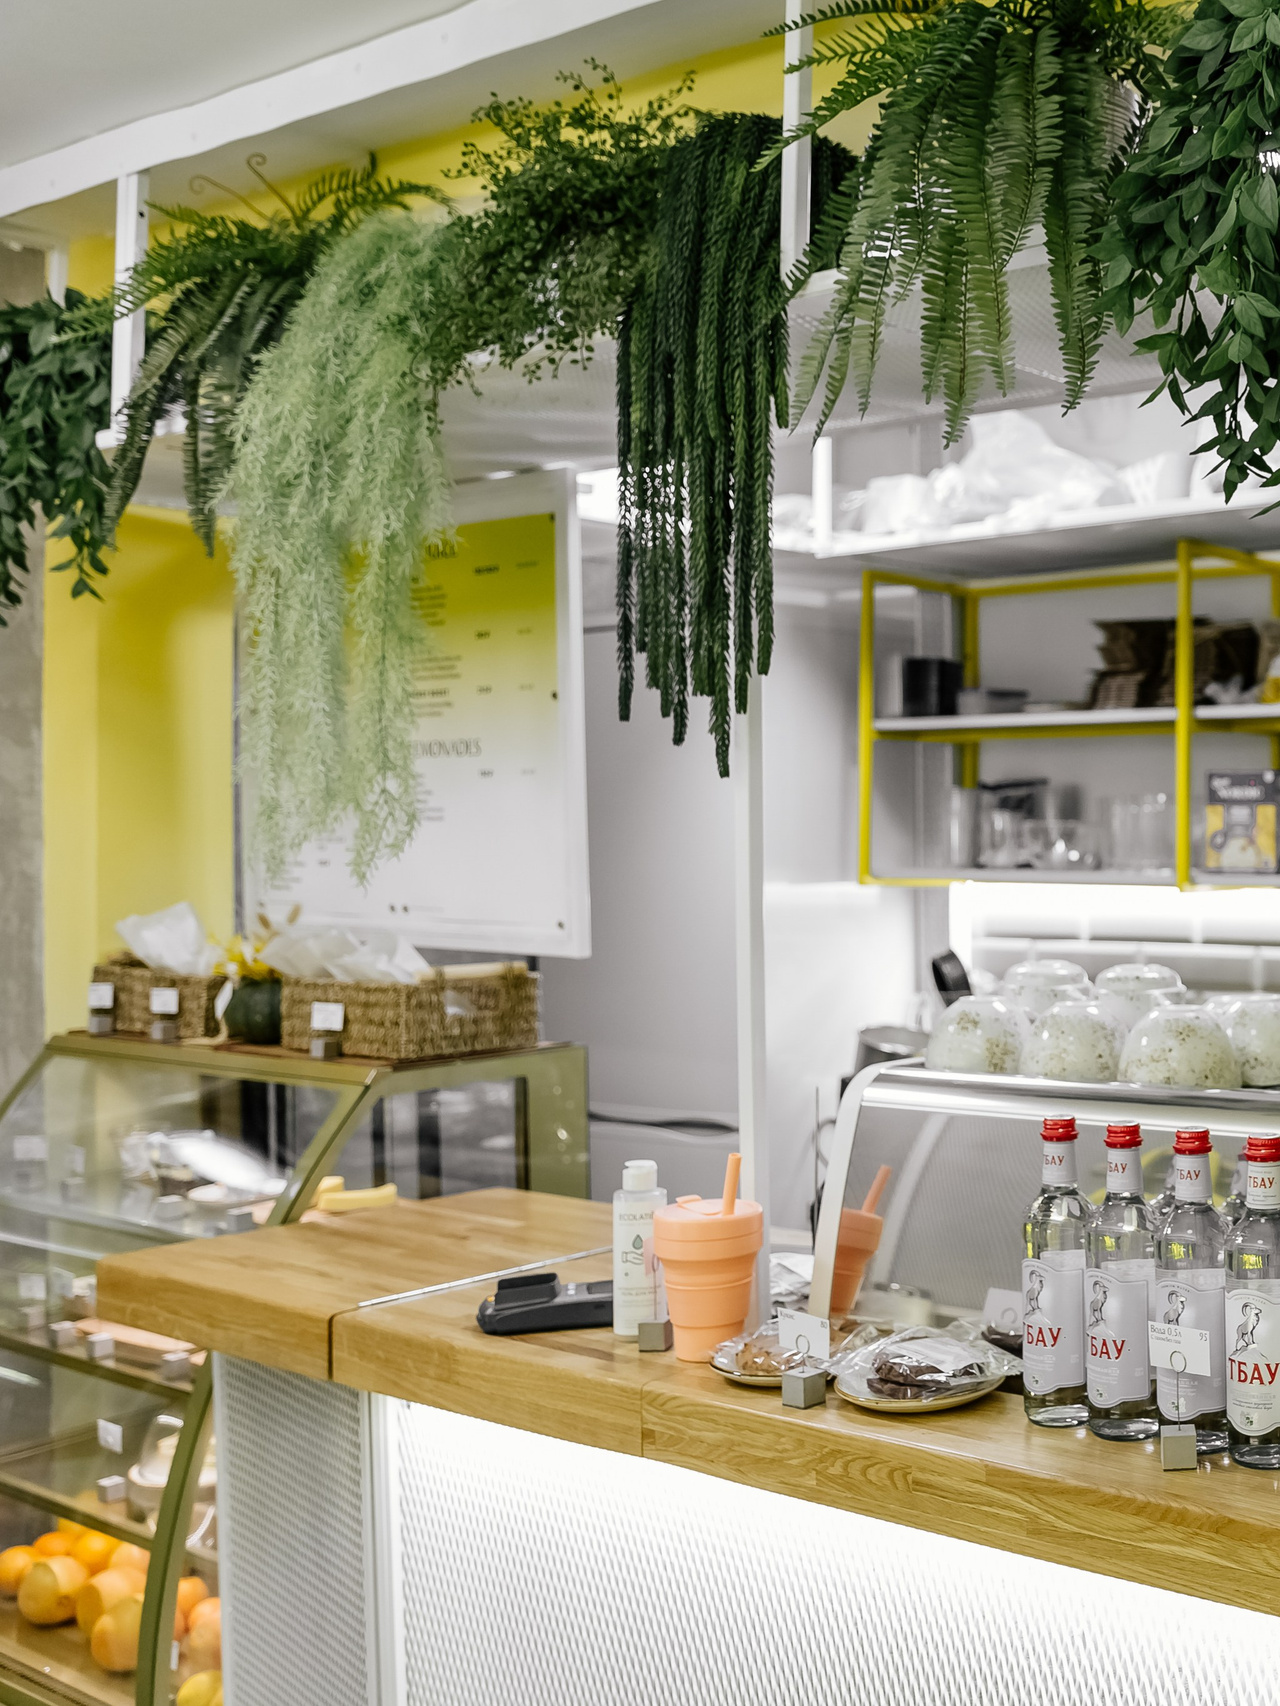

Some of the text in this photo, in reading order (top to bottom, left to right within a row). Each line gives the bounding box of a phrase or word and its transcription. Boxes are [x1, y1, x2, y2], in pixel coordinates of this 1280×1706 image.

[1108, 1160, 1128, 1174] БАУ
[1248, 1175, 1275, 1189] ТБАУ
[1023, 1322, 1062, 1348] БАУ
[1150, 1324, 1166, 1335] Вода
[1199, 1332, 1208, 1342] 95
[1086, 1332, 1126, 1360] БАУ
[1228, 1357, 1280, 1385] ТБАУ
